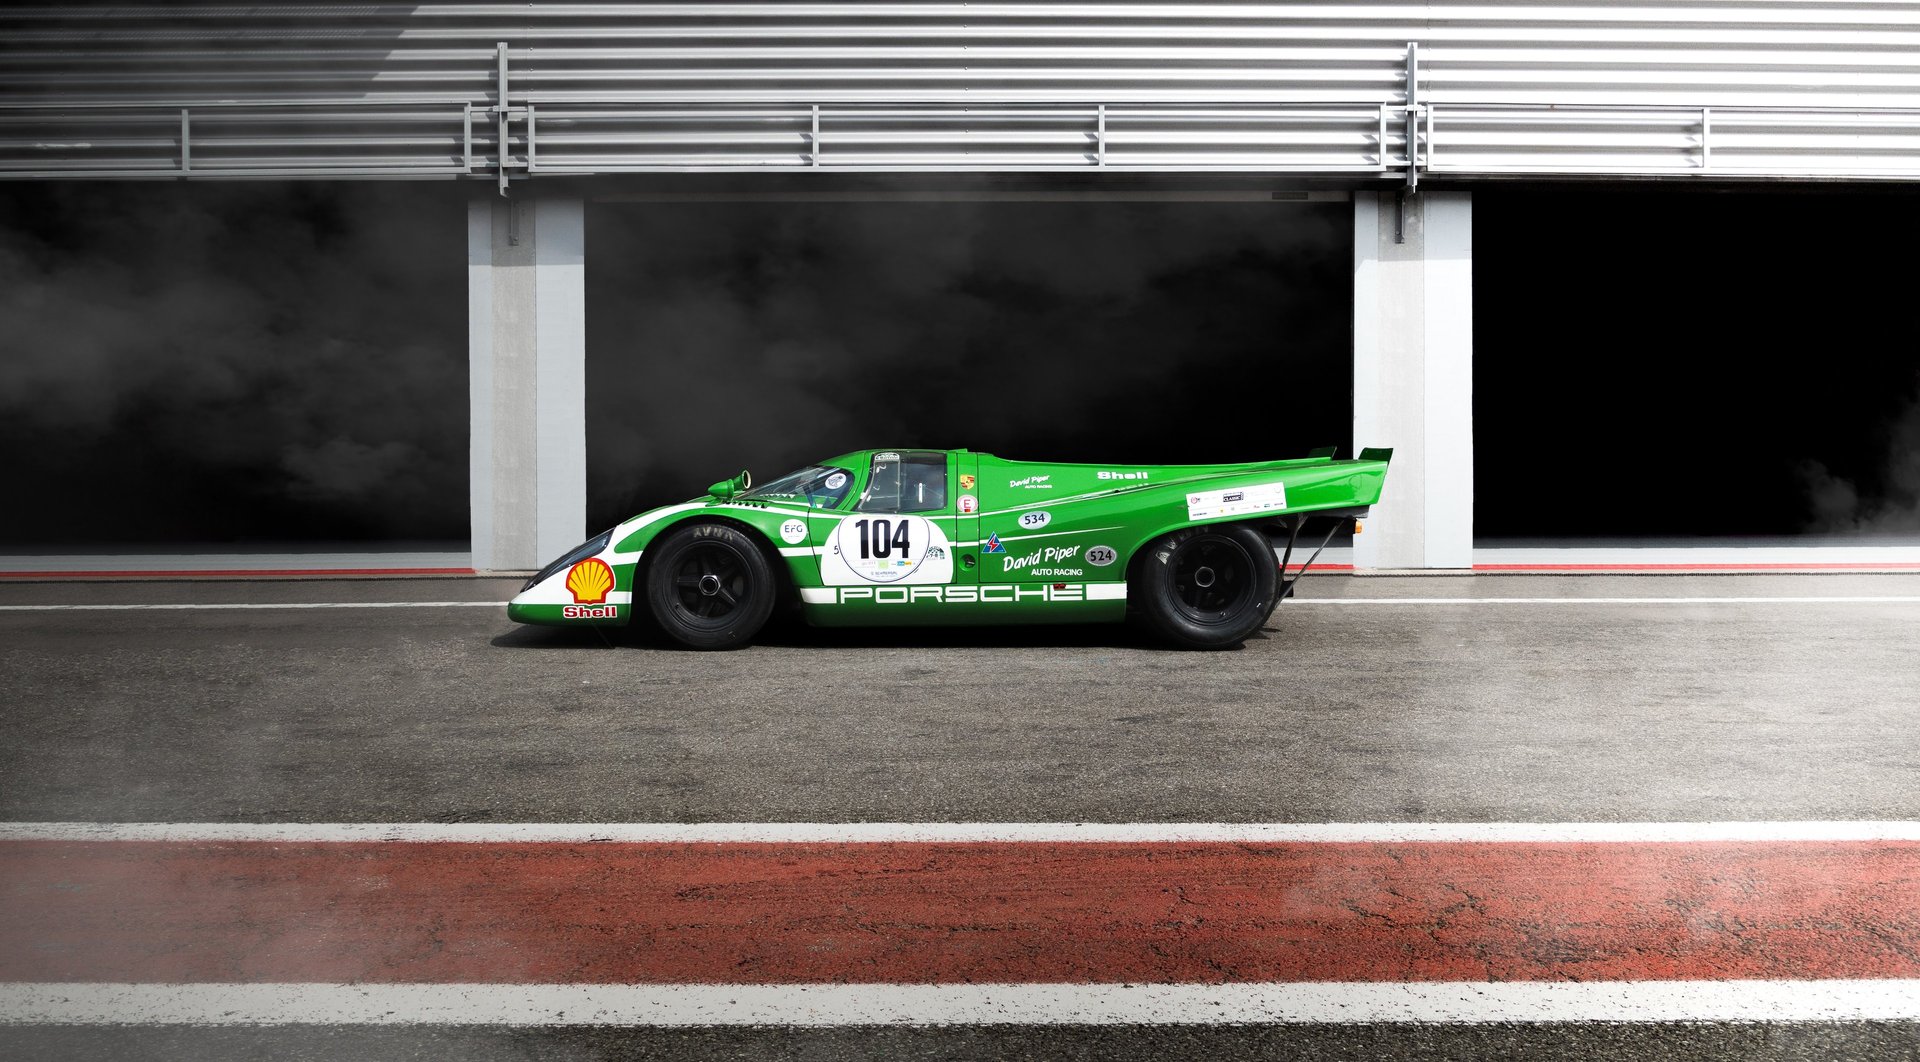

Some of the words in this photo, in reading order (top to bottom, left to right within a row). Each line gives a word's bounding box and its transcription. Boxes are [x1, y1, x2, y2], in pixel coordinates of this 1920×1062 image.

[1097, 471, 1148, 479] Shell
[1010, 477, 1030, 488] David
[1031, 475, 1050, 483] Piper
[1024, 513, 1045, 525] 534
[784, 524, 803, 533] EFG
[855, 519, 910, 559] 104
[1003, 548, 1042, 571] David
[1044, 545, 1080, 563] Piper
[1090, 551, 1112, 562] 524
[1031, 568, 1052, 576] AUTO
[1054, 568, 1083, 576] RACING
[841, 586, 1082, 604] PORSCHE
[564, 605, 617, 619] Shell
